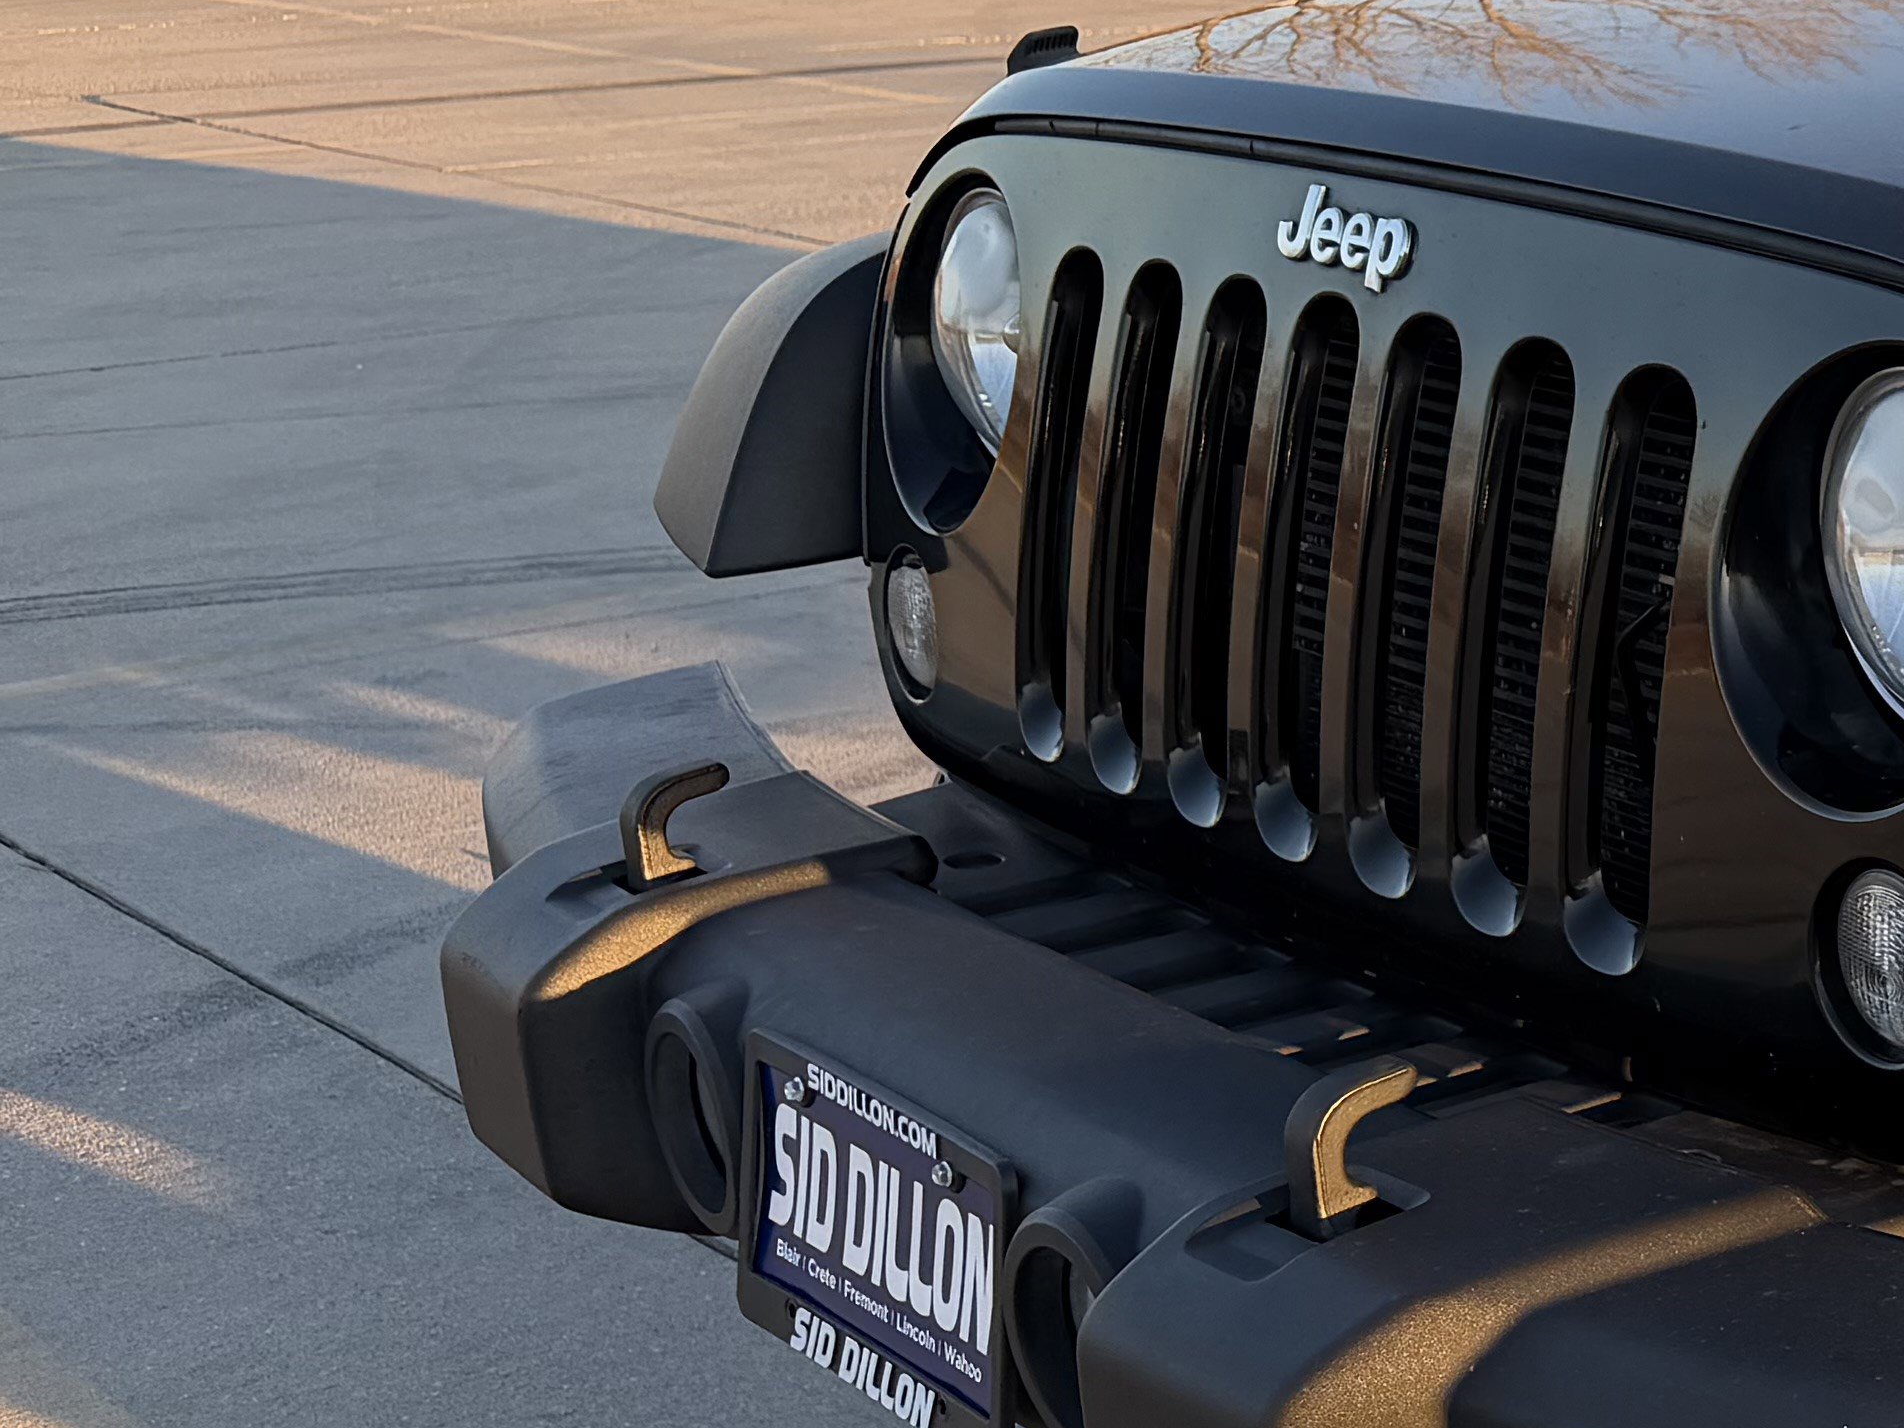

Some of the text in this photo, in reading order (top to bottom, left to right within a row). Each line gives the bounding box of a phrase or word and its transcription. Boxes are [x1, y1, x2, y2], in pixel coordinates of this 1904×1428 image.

[1277, 183, 1411, 294] Jeep
[807, 1062, 938, 1160] SIDDILLON.COM
[768, 1102, 995, 1356] SID DILLON
[776, 1238, 982, 1383] Blair Crete Fremont Lincoln Wahoo
[789, 1307, 837, 1370] SID
